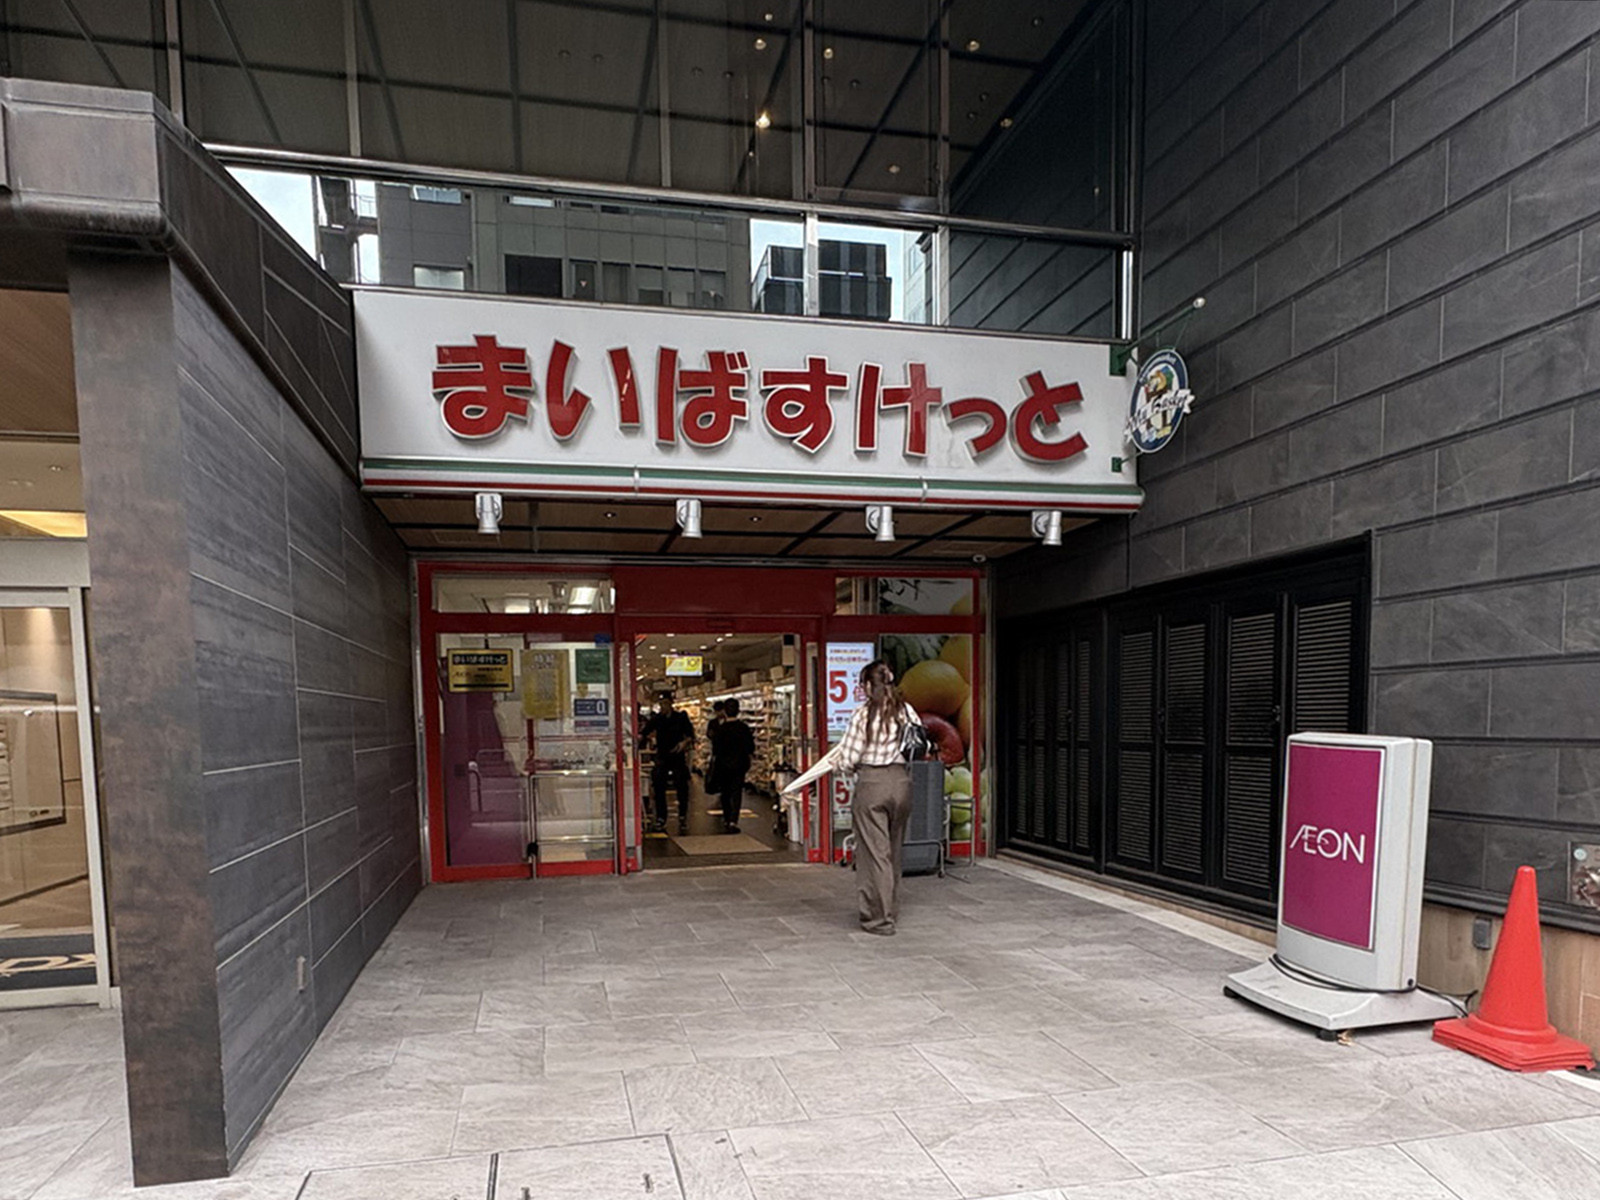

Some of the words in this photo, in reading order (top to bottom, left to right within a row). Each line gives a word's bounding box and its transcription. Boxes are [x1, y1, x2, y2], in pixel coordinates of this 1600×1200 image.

[432, 335, 1089, 463] まいばすけっと
[829, 670, 848, 704] 5
